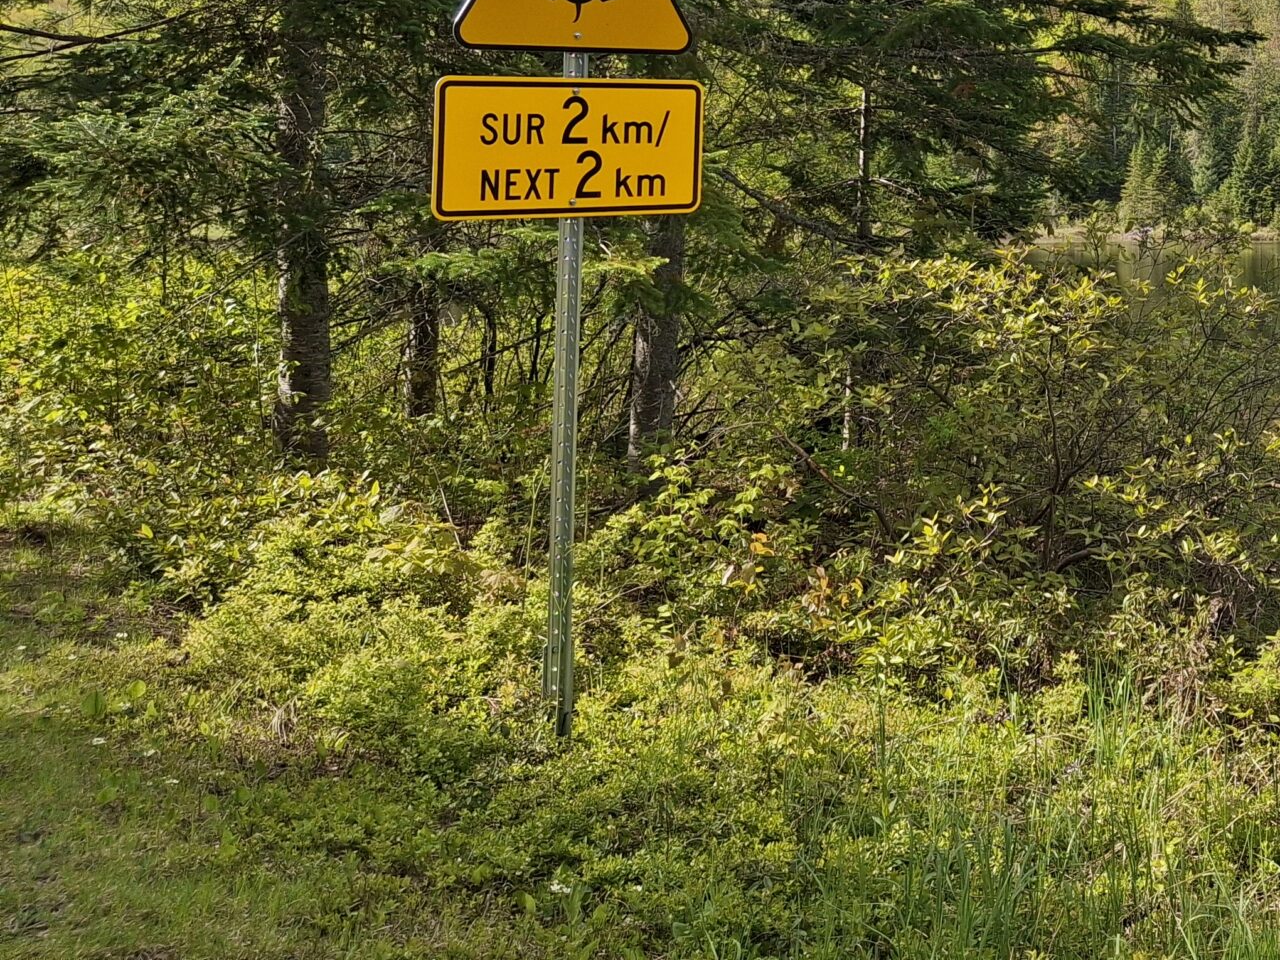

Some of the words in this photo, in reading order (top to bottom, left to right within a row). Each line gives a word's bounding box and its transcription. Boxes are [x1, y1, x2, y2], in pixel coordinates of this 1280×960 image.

[480, 113, 545, 146] SUR
[562, 95, 589, 145] 2
[481, 168, 560, 201] NEXT
[576, 150, 603, 199] 2
[615, 167, 666, 198] km
